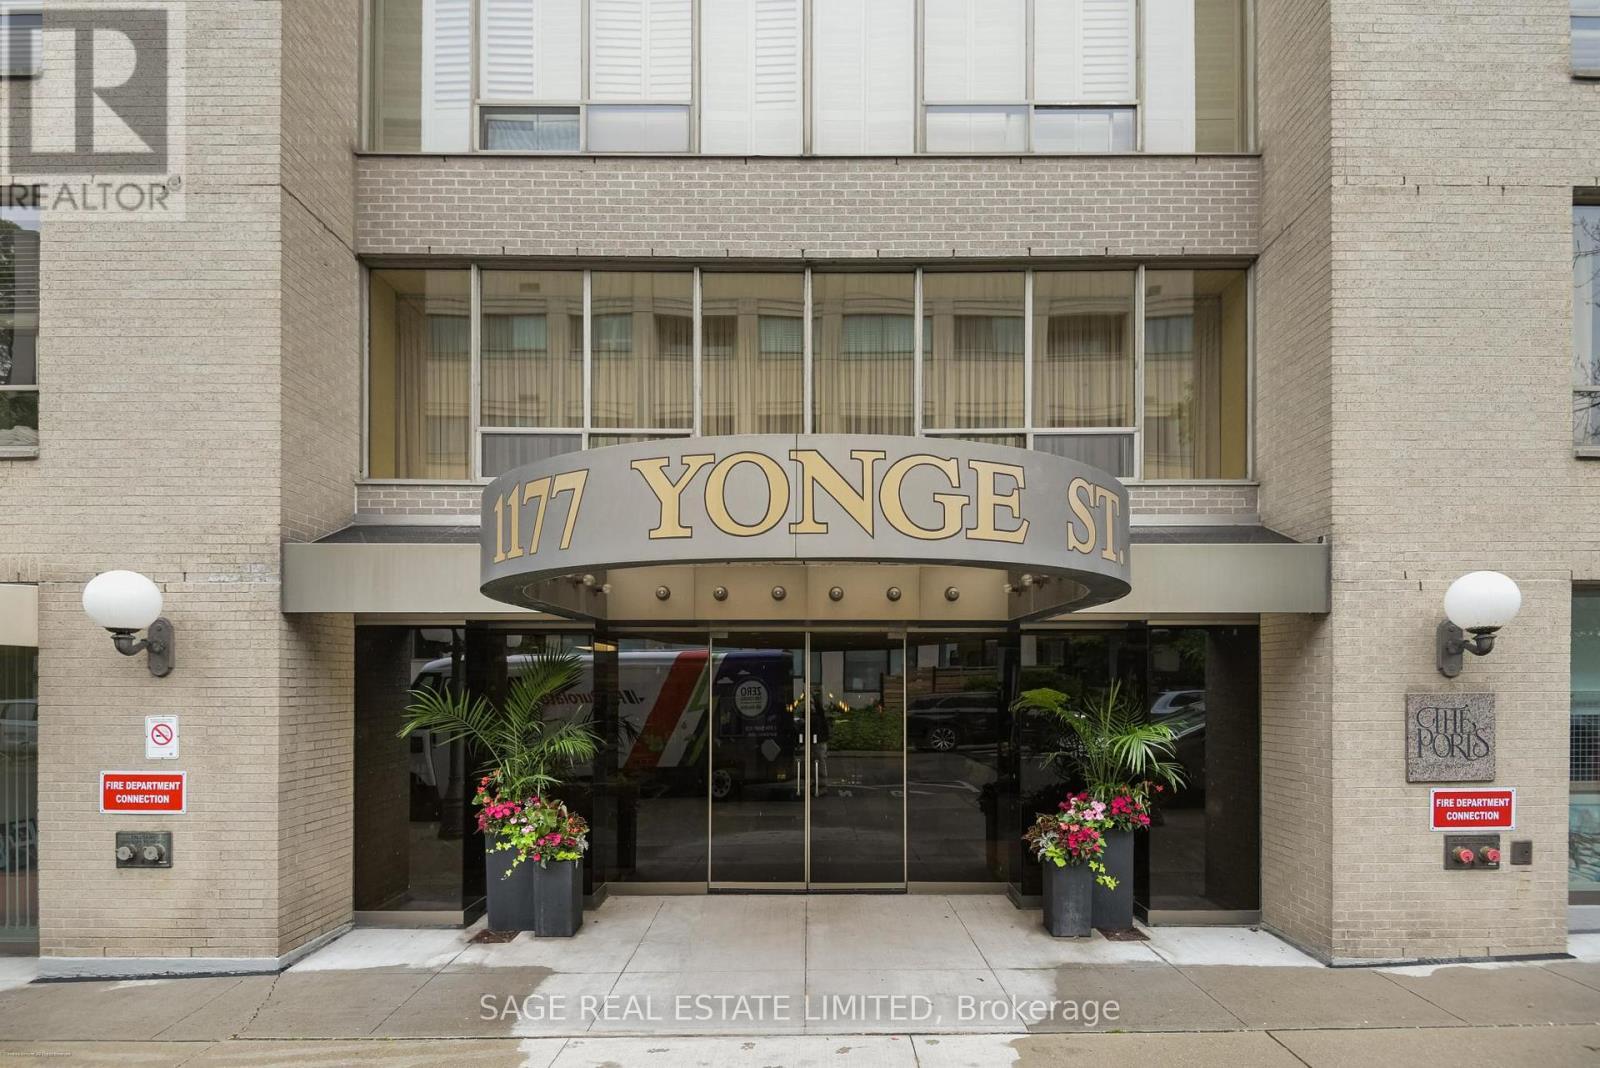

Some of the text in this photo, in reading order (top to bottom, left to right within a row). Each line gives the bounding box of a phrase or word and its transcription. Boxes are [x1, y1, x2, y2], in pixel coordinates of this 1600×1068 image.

[493, 449, 1125, 567] 1177 YONGE ST.
[106, 781, 181, 790] FIRE DEPARTMENT
[115, 794, 170, 804] CONNECTION
[1436, 798, 1510, 807] FIRE DEPARTMENT
[1446, 811, 1500, 820] CONNECTION
